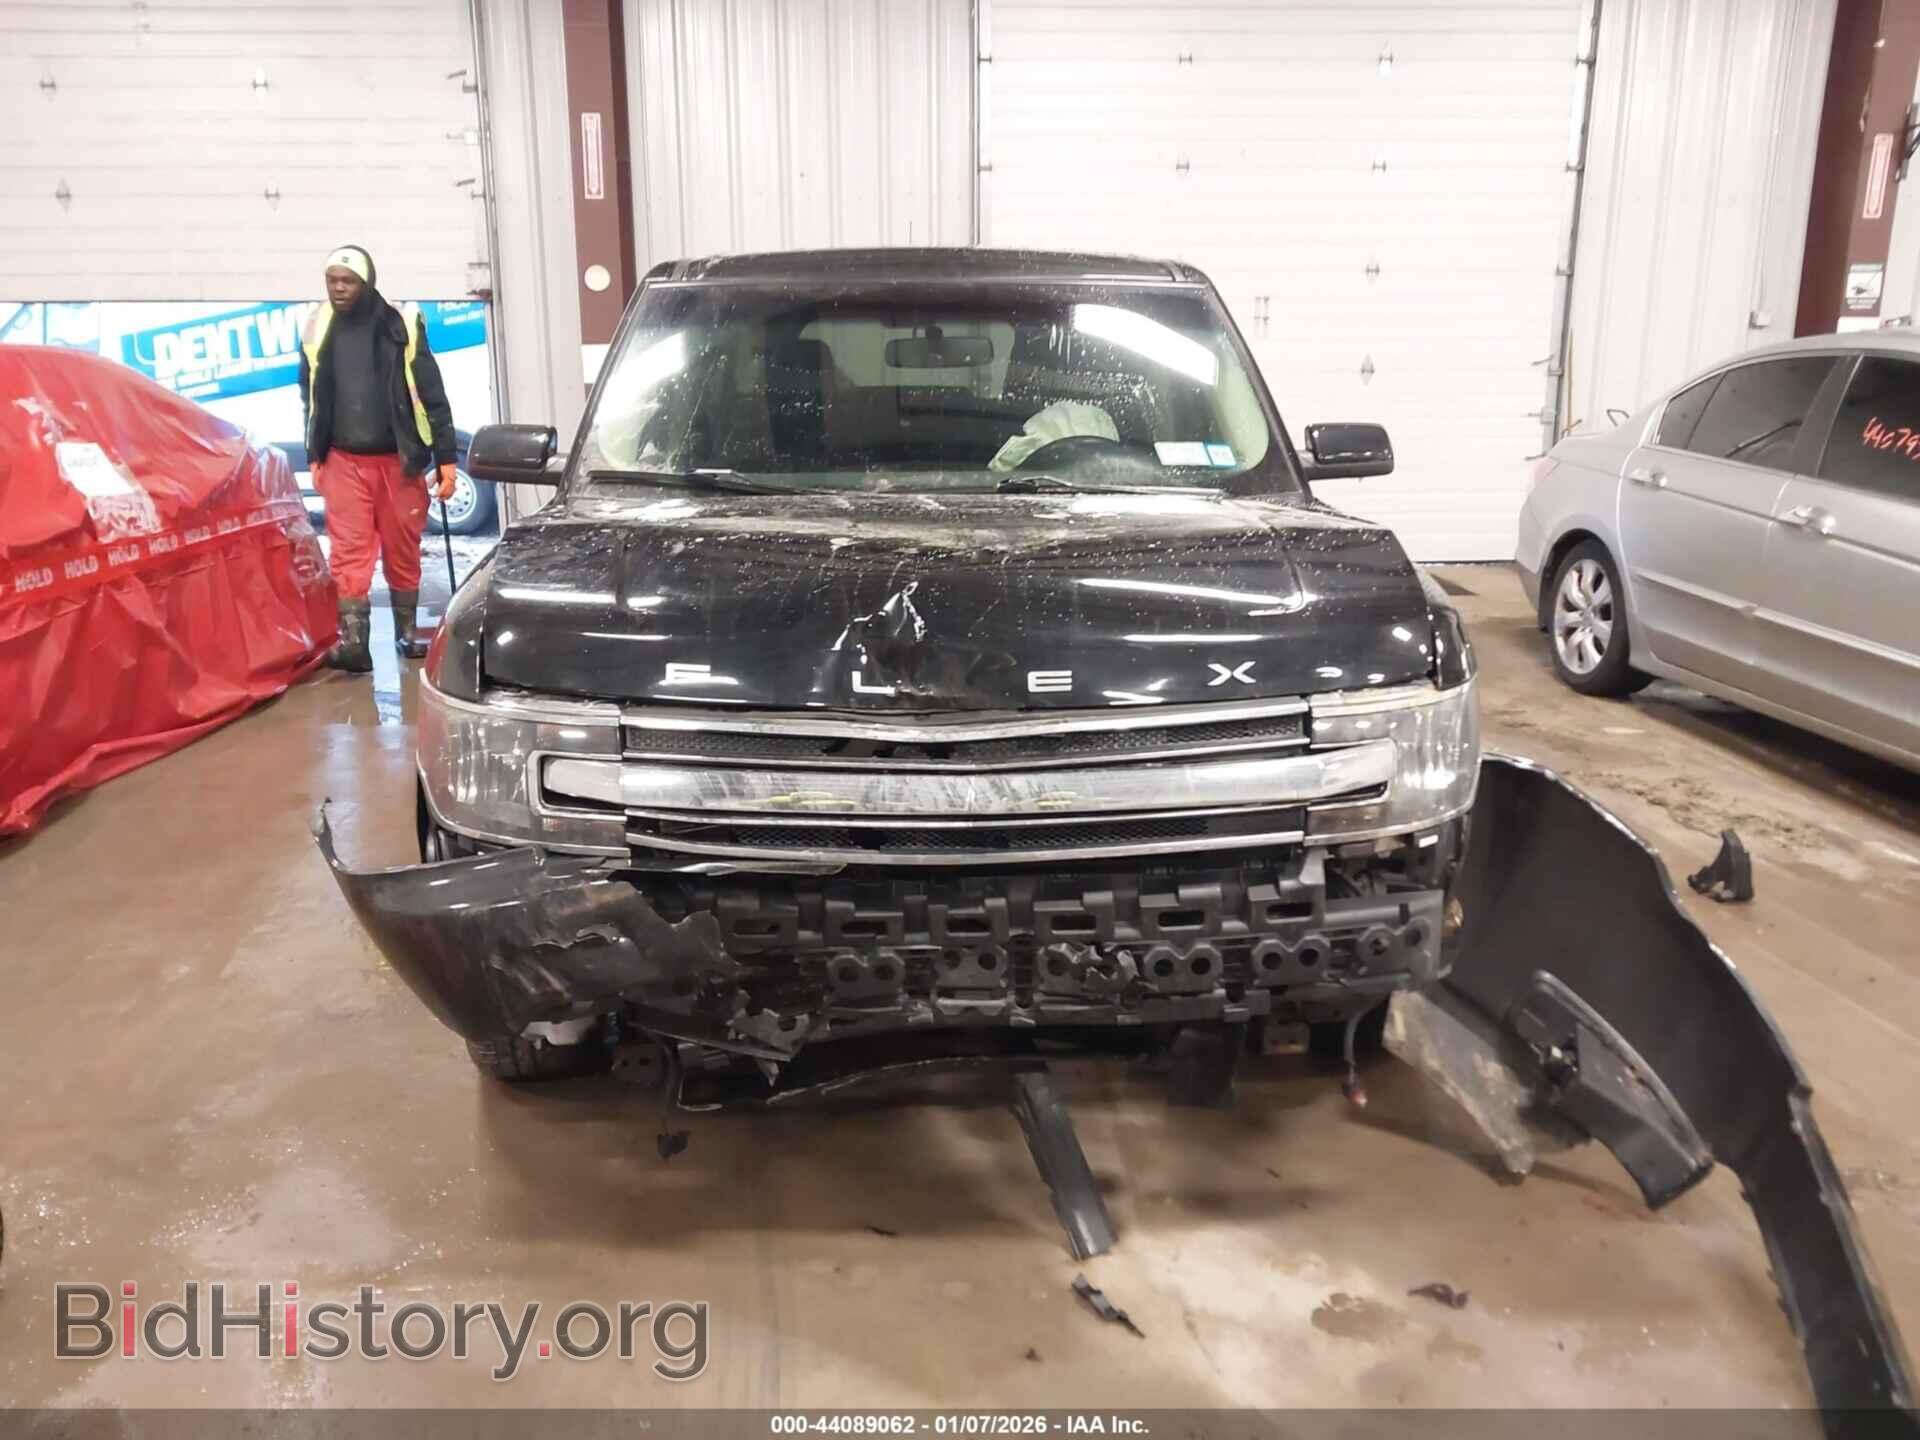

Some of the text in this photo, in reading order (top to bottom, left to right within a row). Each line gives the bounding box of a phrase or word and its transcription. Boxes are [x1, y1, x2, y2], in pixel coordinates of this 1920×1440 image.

[15, 567, 53, 593] HOLD
[64, 555, 99, 579] HOLD
[107, 543, 140, 566] HOLD
[149, 534, 178, 556] HOLD
